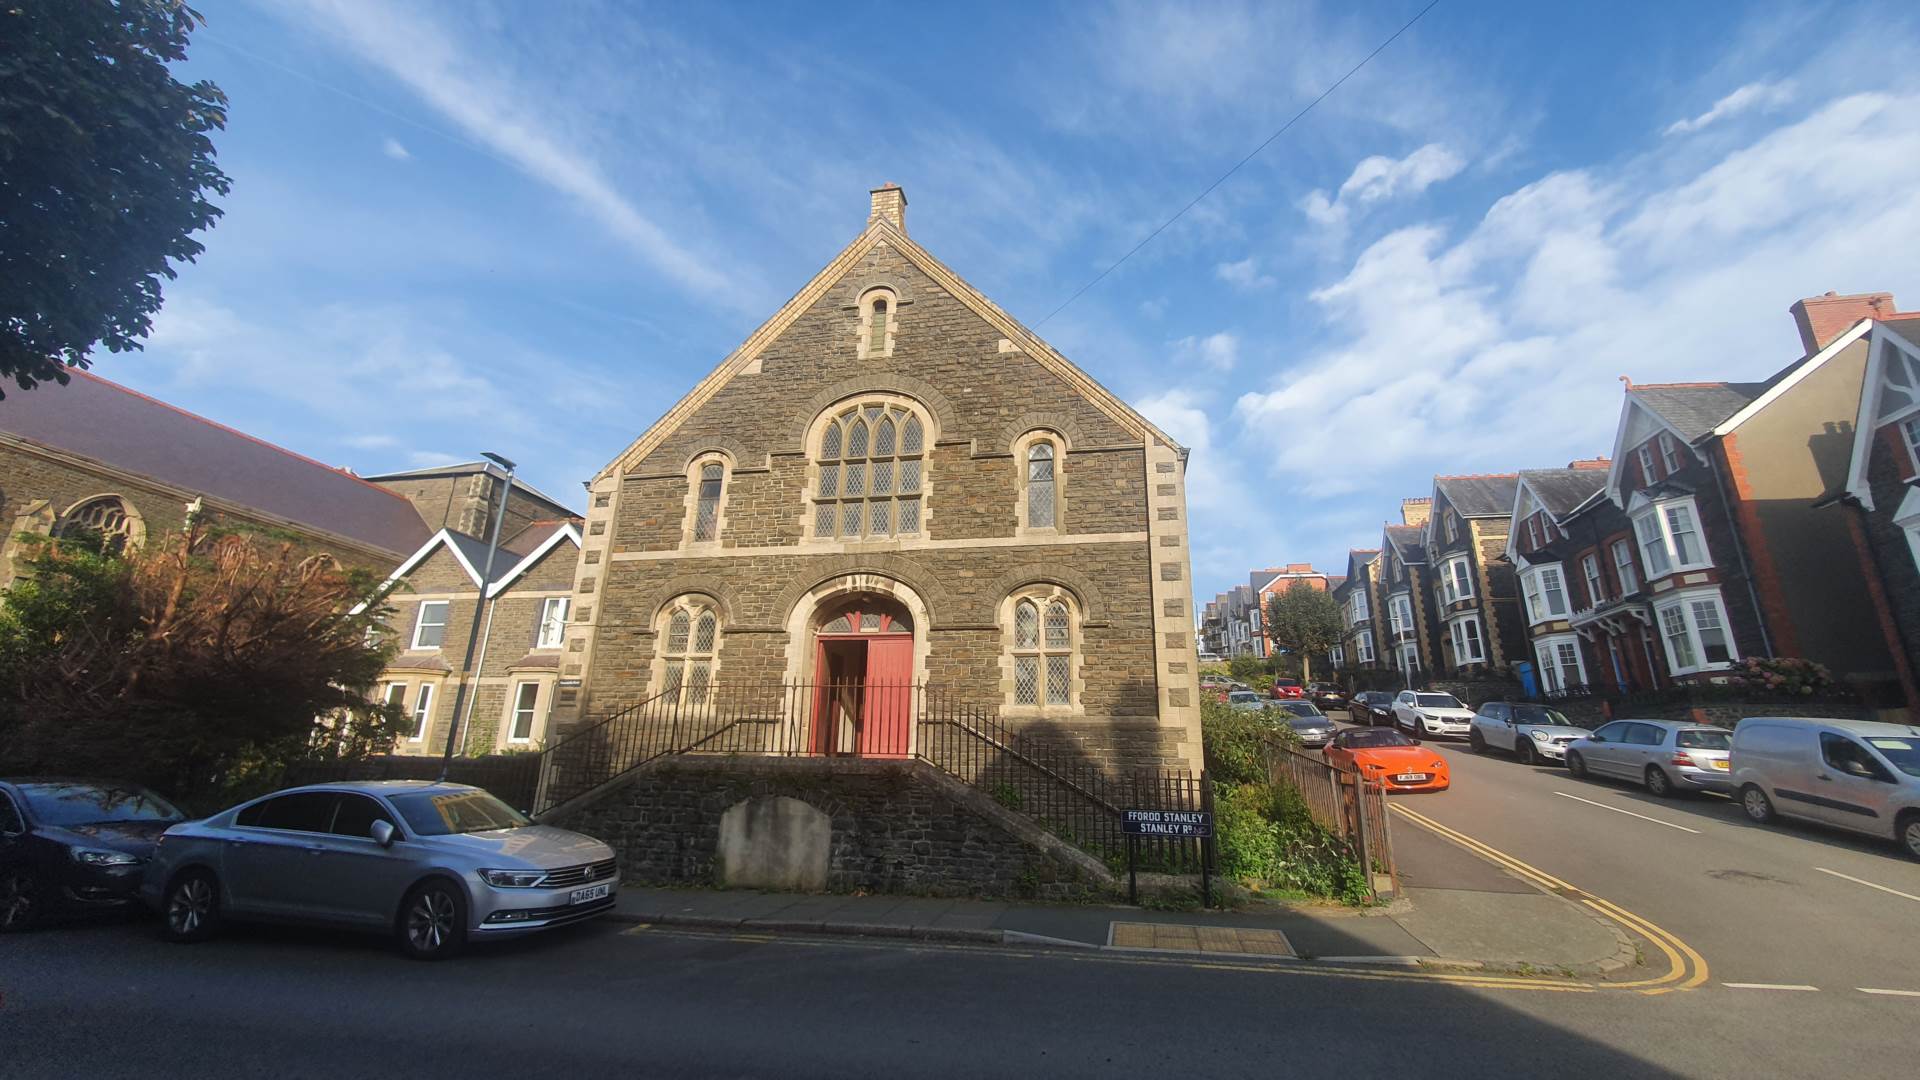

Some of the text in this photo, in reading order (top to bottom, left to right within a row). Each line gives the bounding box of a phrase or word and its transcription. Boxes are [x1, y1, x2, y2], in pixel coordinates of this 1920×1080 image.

[1128, 811, 1203, 823] FFORDD STANLEY
[1140, 823, 1179, 834] STANLEY
